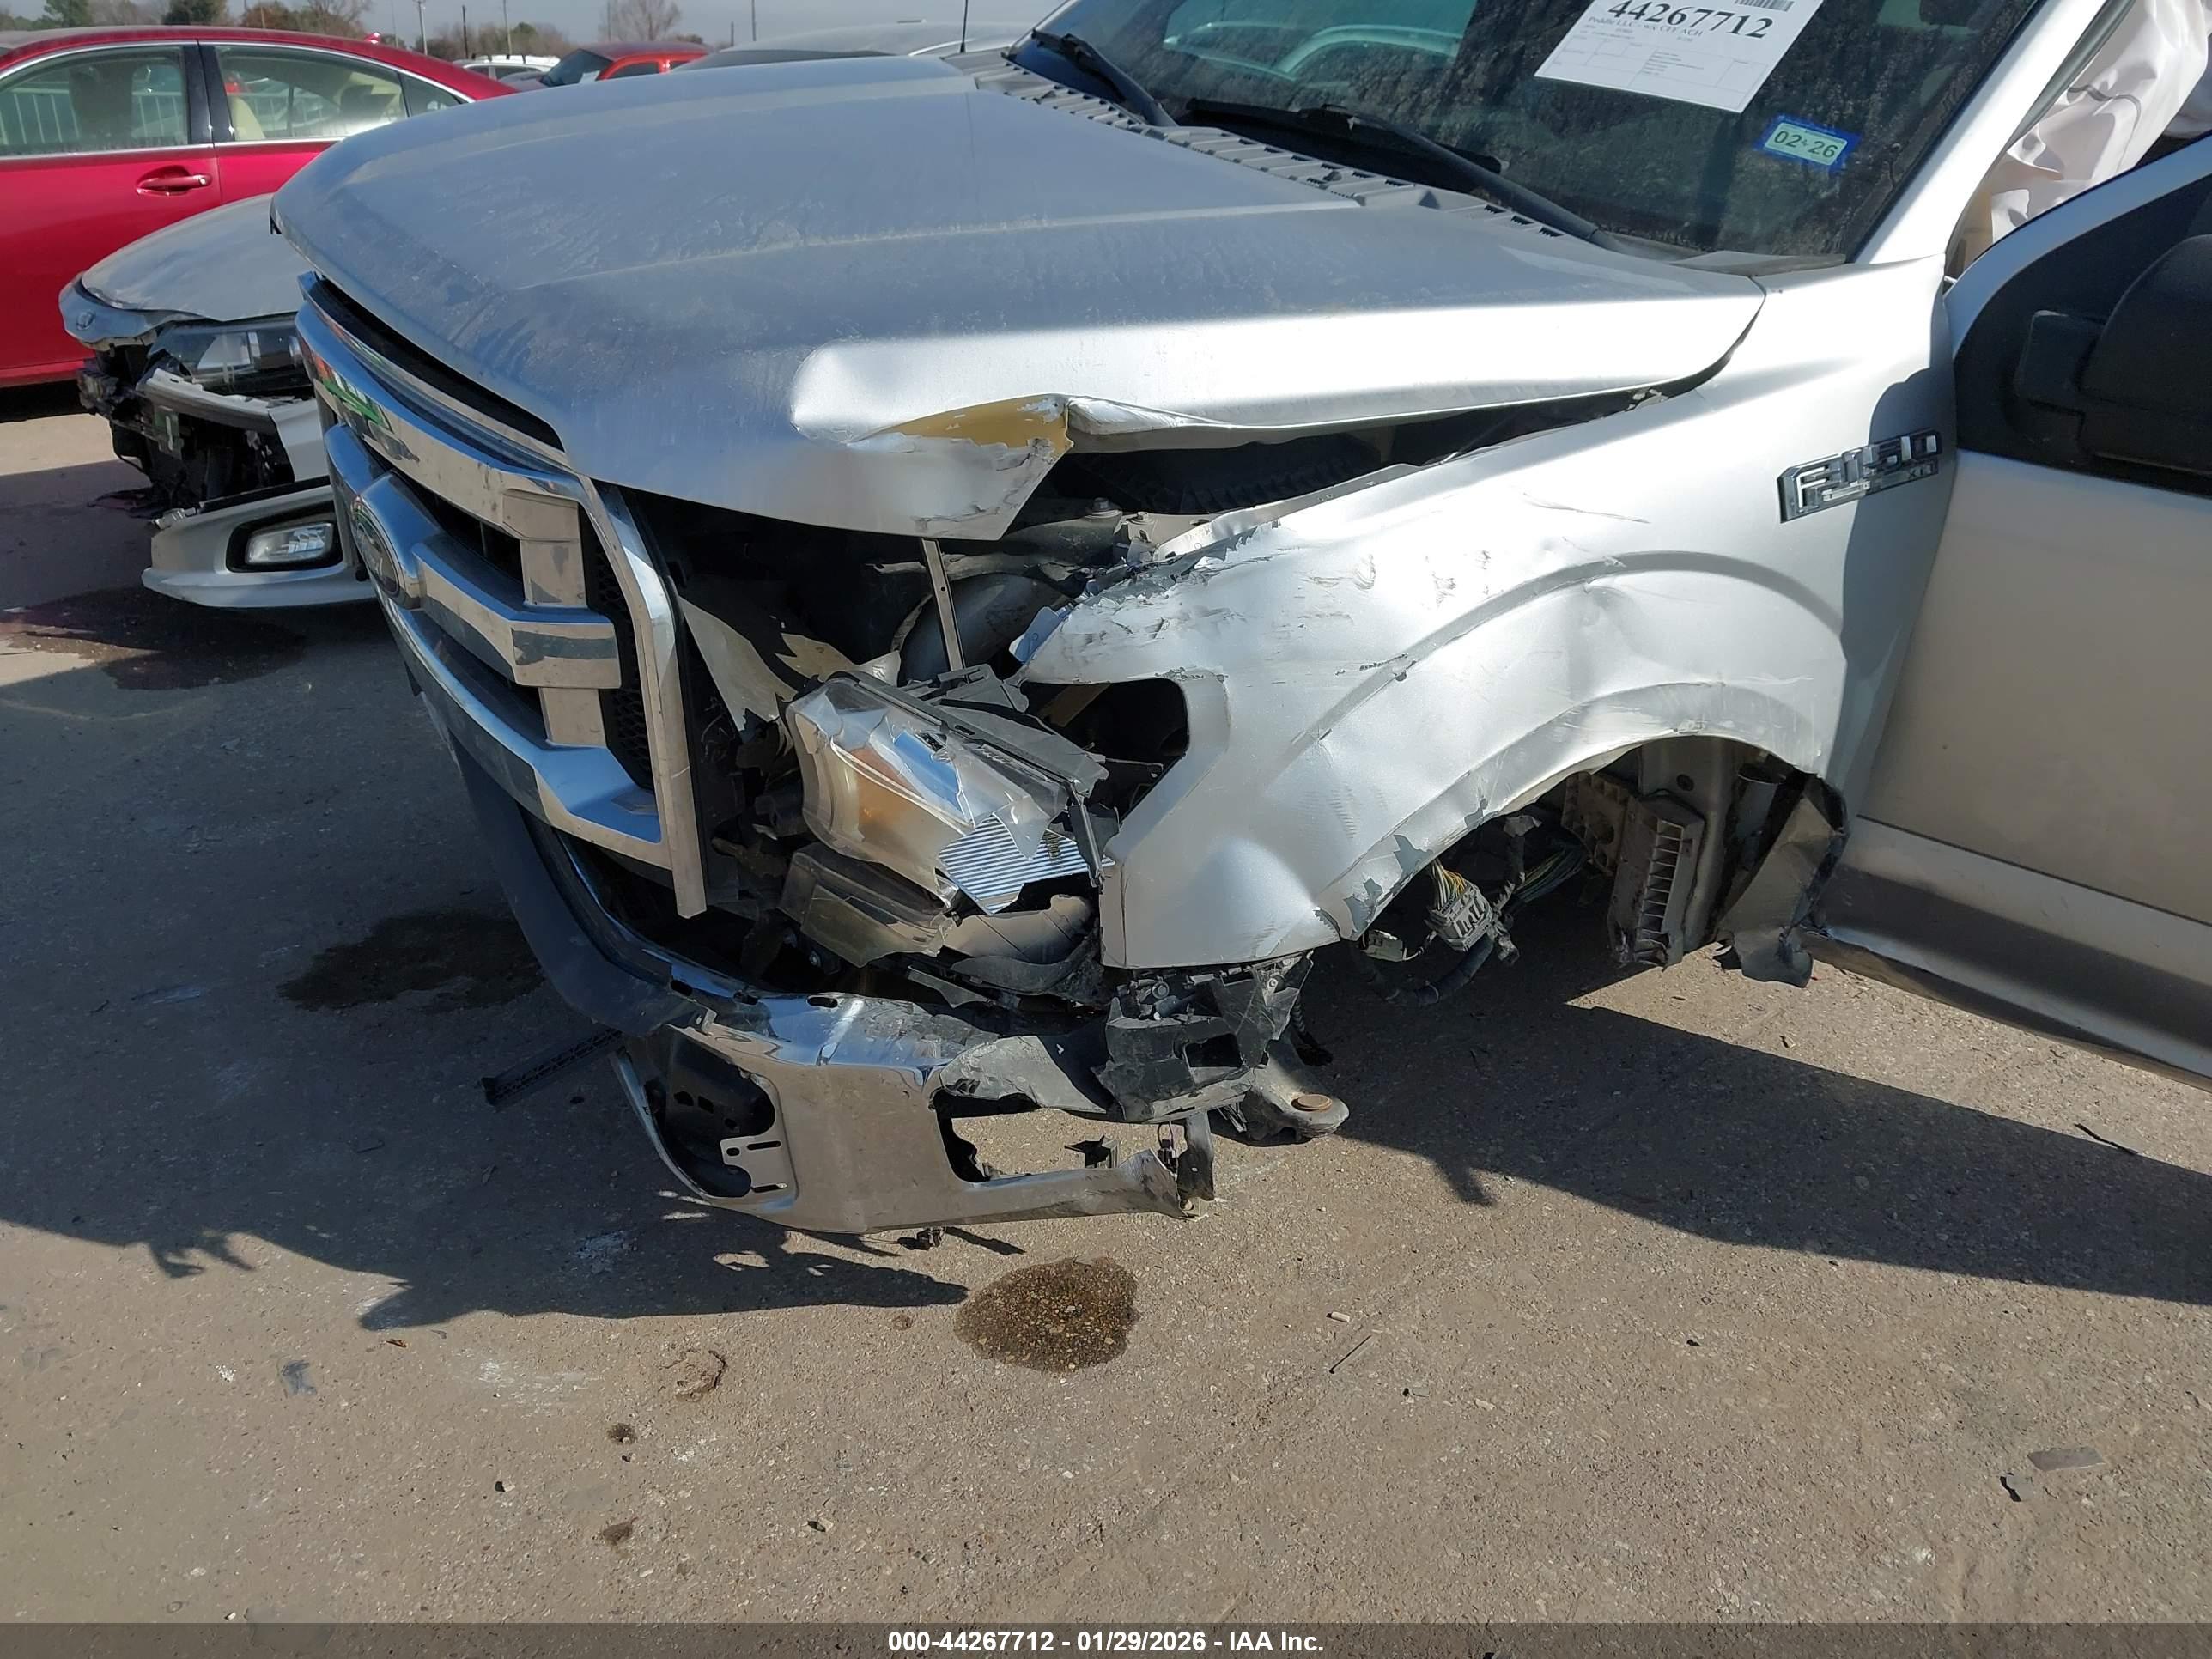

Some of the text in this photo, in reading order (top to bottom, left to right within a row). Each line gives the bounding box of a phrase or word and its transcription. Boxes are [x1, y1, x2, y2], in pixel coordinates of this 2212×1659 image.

[1607, 0, 1773, 38] 44267712
[1774, 131, 1802, 148] 02
[1808, 140, 1838, 158] 26
